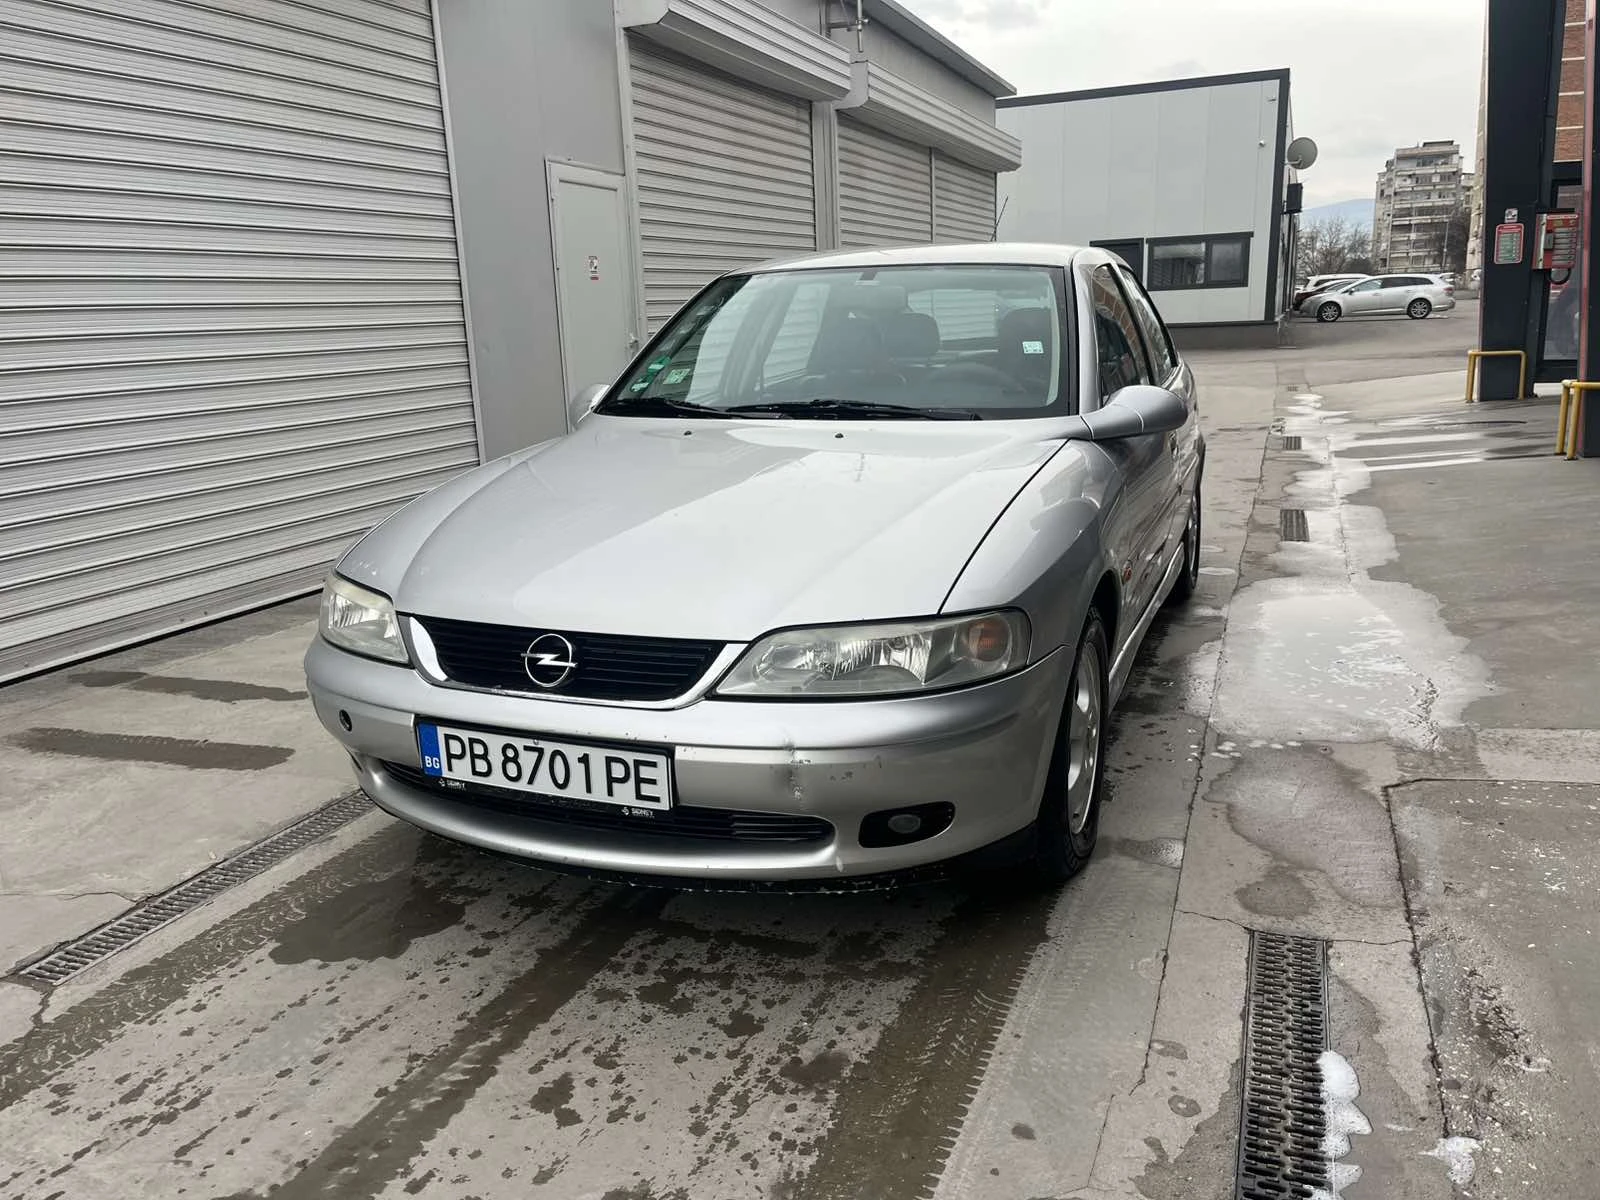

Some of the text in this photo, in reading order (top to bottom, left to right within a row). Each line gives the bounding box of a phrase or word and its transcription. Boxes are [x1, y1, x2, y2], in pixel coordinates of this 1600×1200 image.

[425, 755, 440, 769] BG
[444, 733, 661, 803] PB 8701 PE
